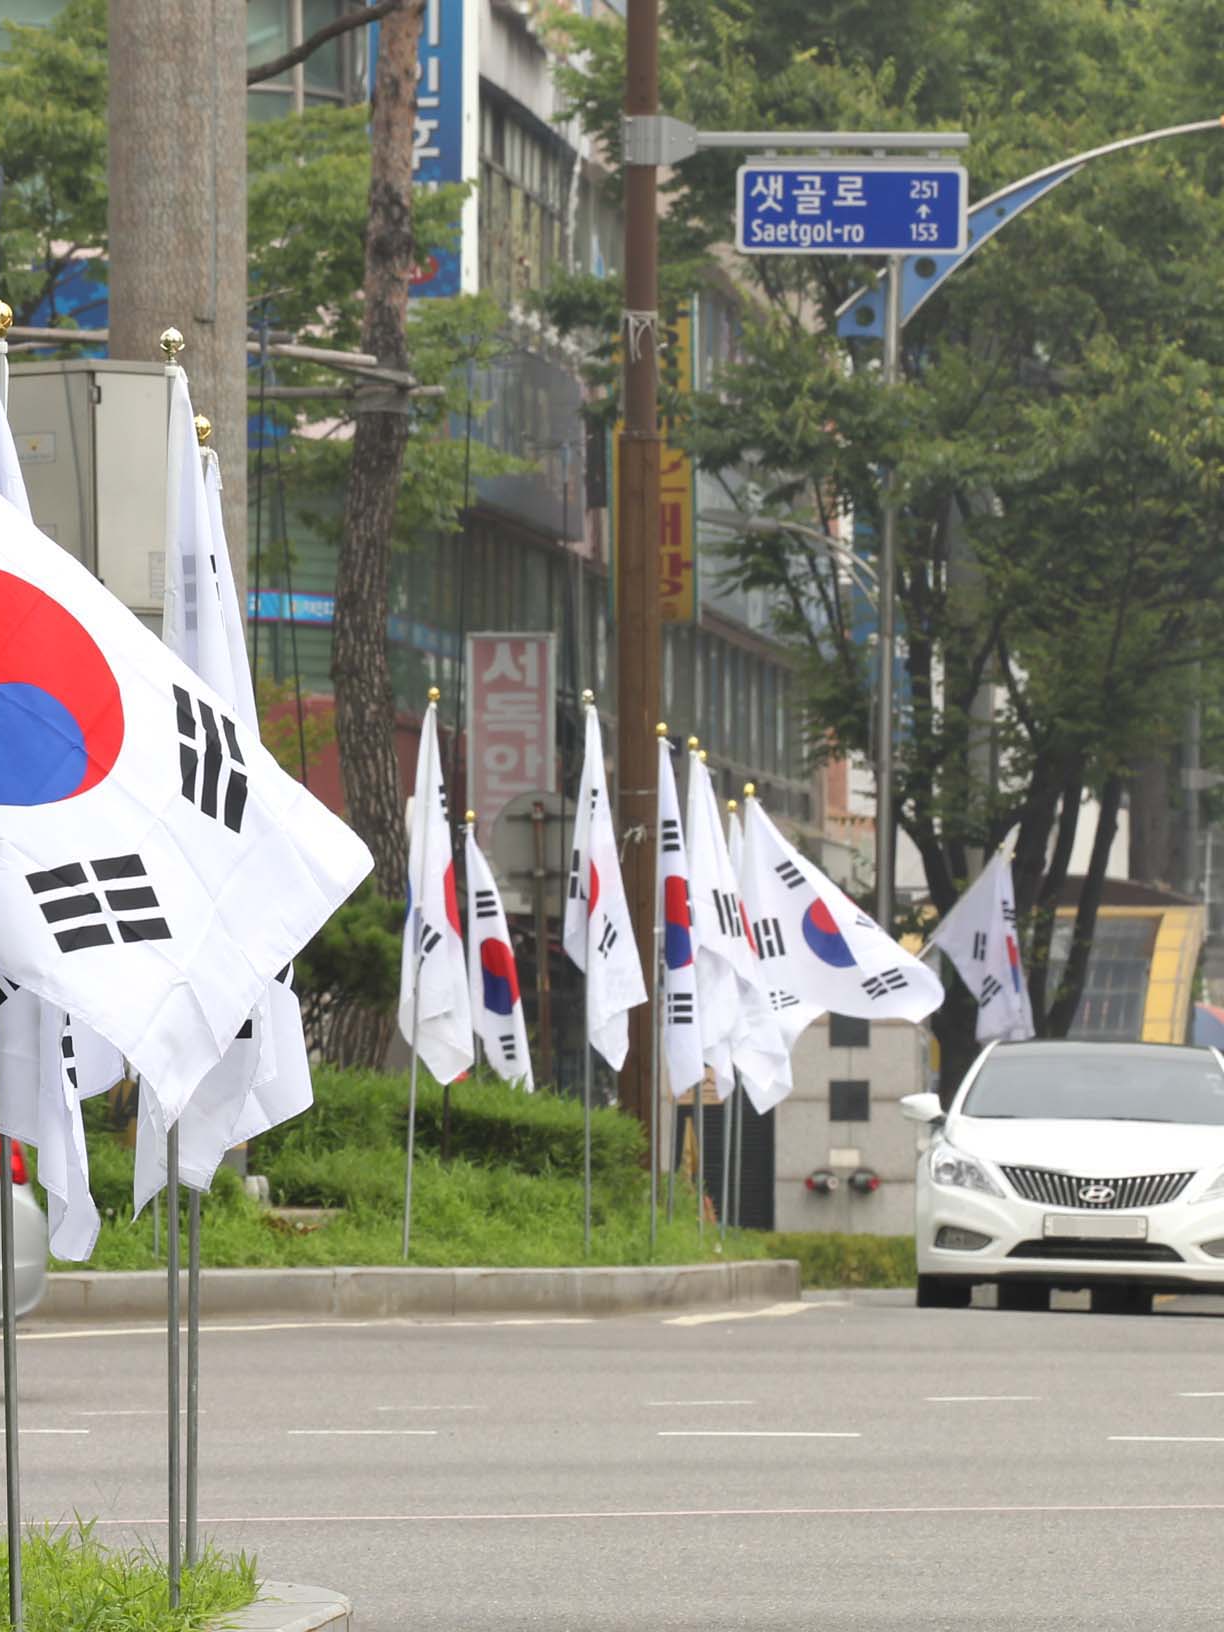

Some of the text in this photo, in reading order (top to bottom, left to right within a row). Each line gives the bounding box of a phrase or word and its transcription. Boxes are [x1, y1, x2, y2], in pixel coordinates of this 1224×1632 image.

[751, 175, 867, 215] 샛골로
[910, 180, 939, 199] 251
[751, 219, 865, 246] Saetgol-ro
[910, 223, 939, 241] 153
